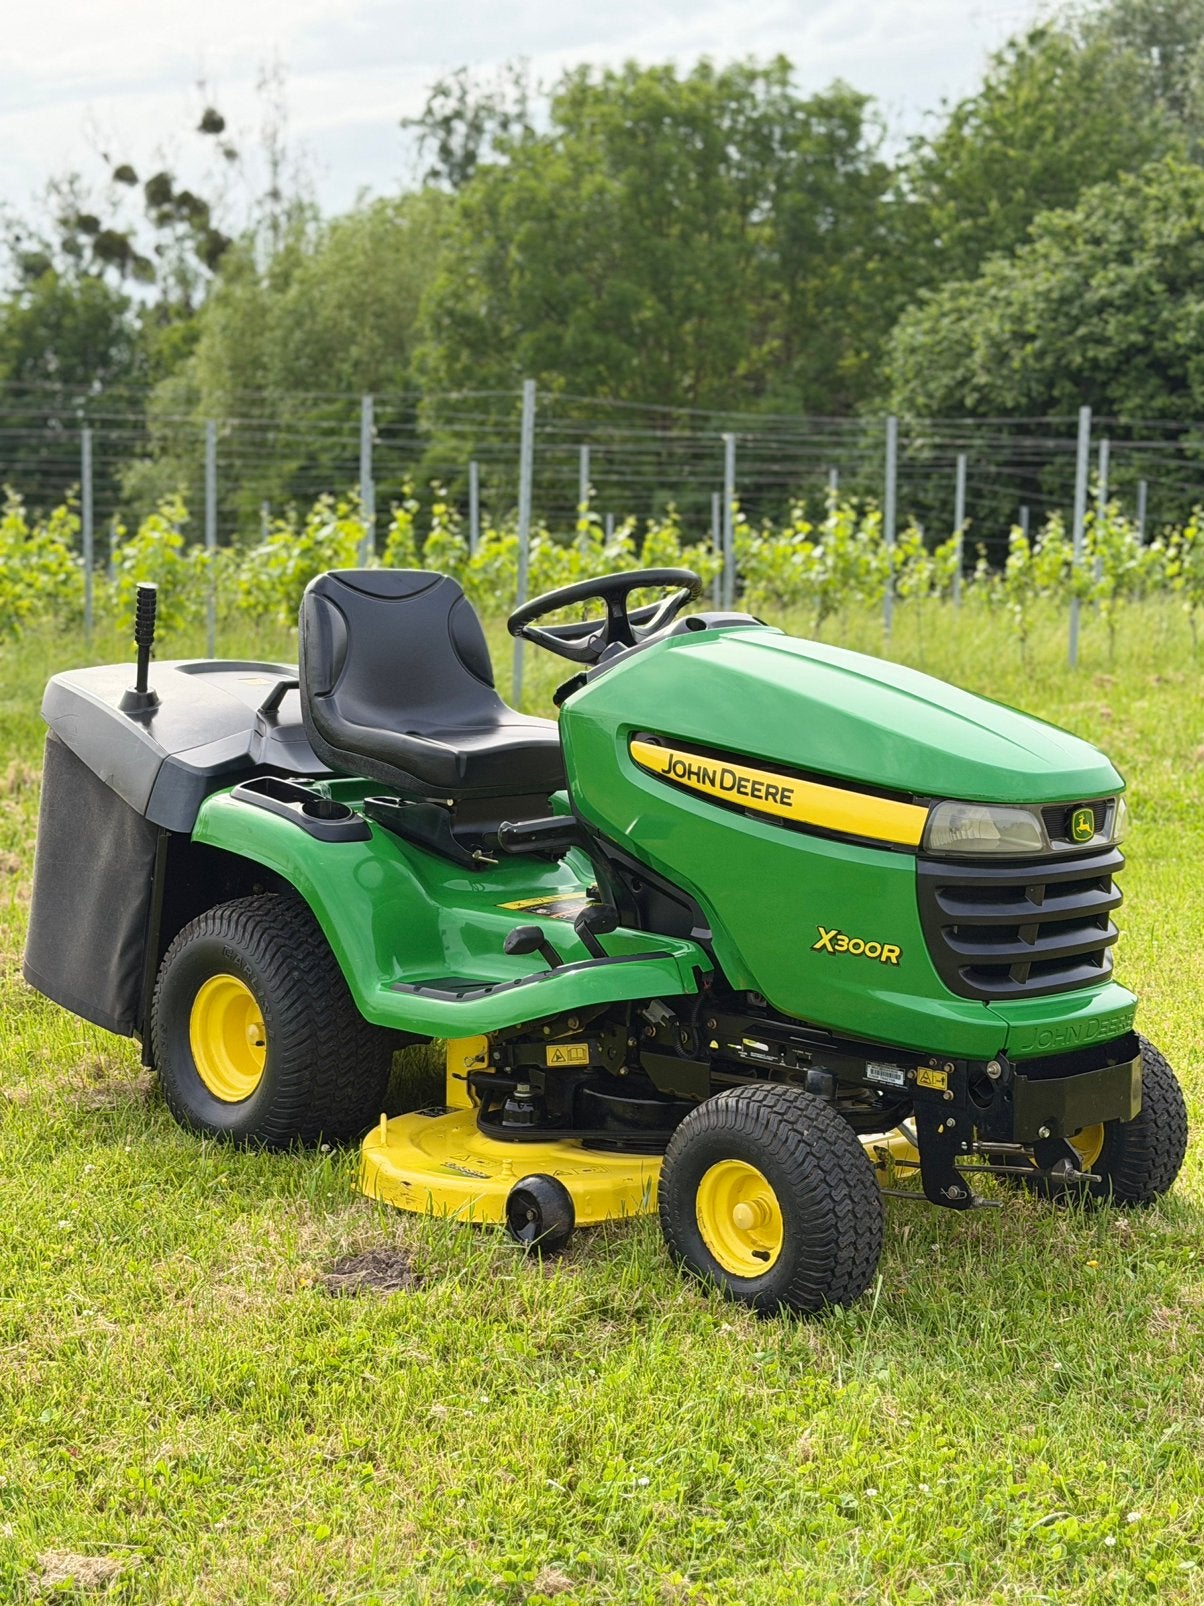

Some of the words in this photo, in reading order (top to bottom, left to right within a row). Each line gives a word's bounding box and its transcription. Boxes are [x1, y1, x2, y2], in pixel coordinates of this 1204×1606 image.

[661, 753, 717, 789] JOHN
[719, 768, 795, 808] DEERE
[811, 926, 902, 966] X300R
[1020, 1024, 1083, 1051] JOHN
[1085, 1012, 1133, 1040] DEERE
